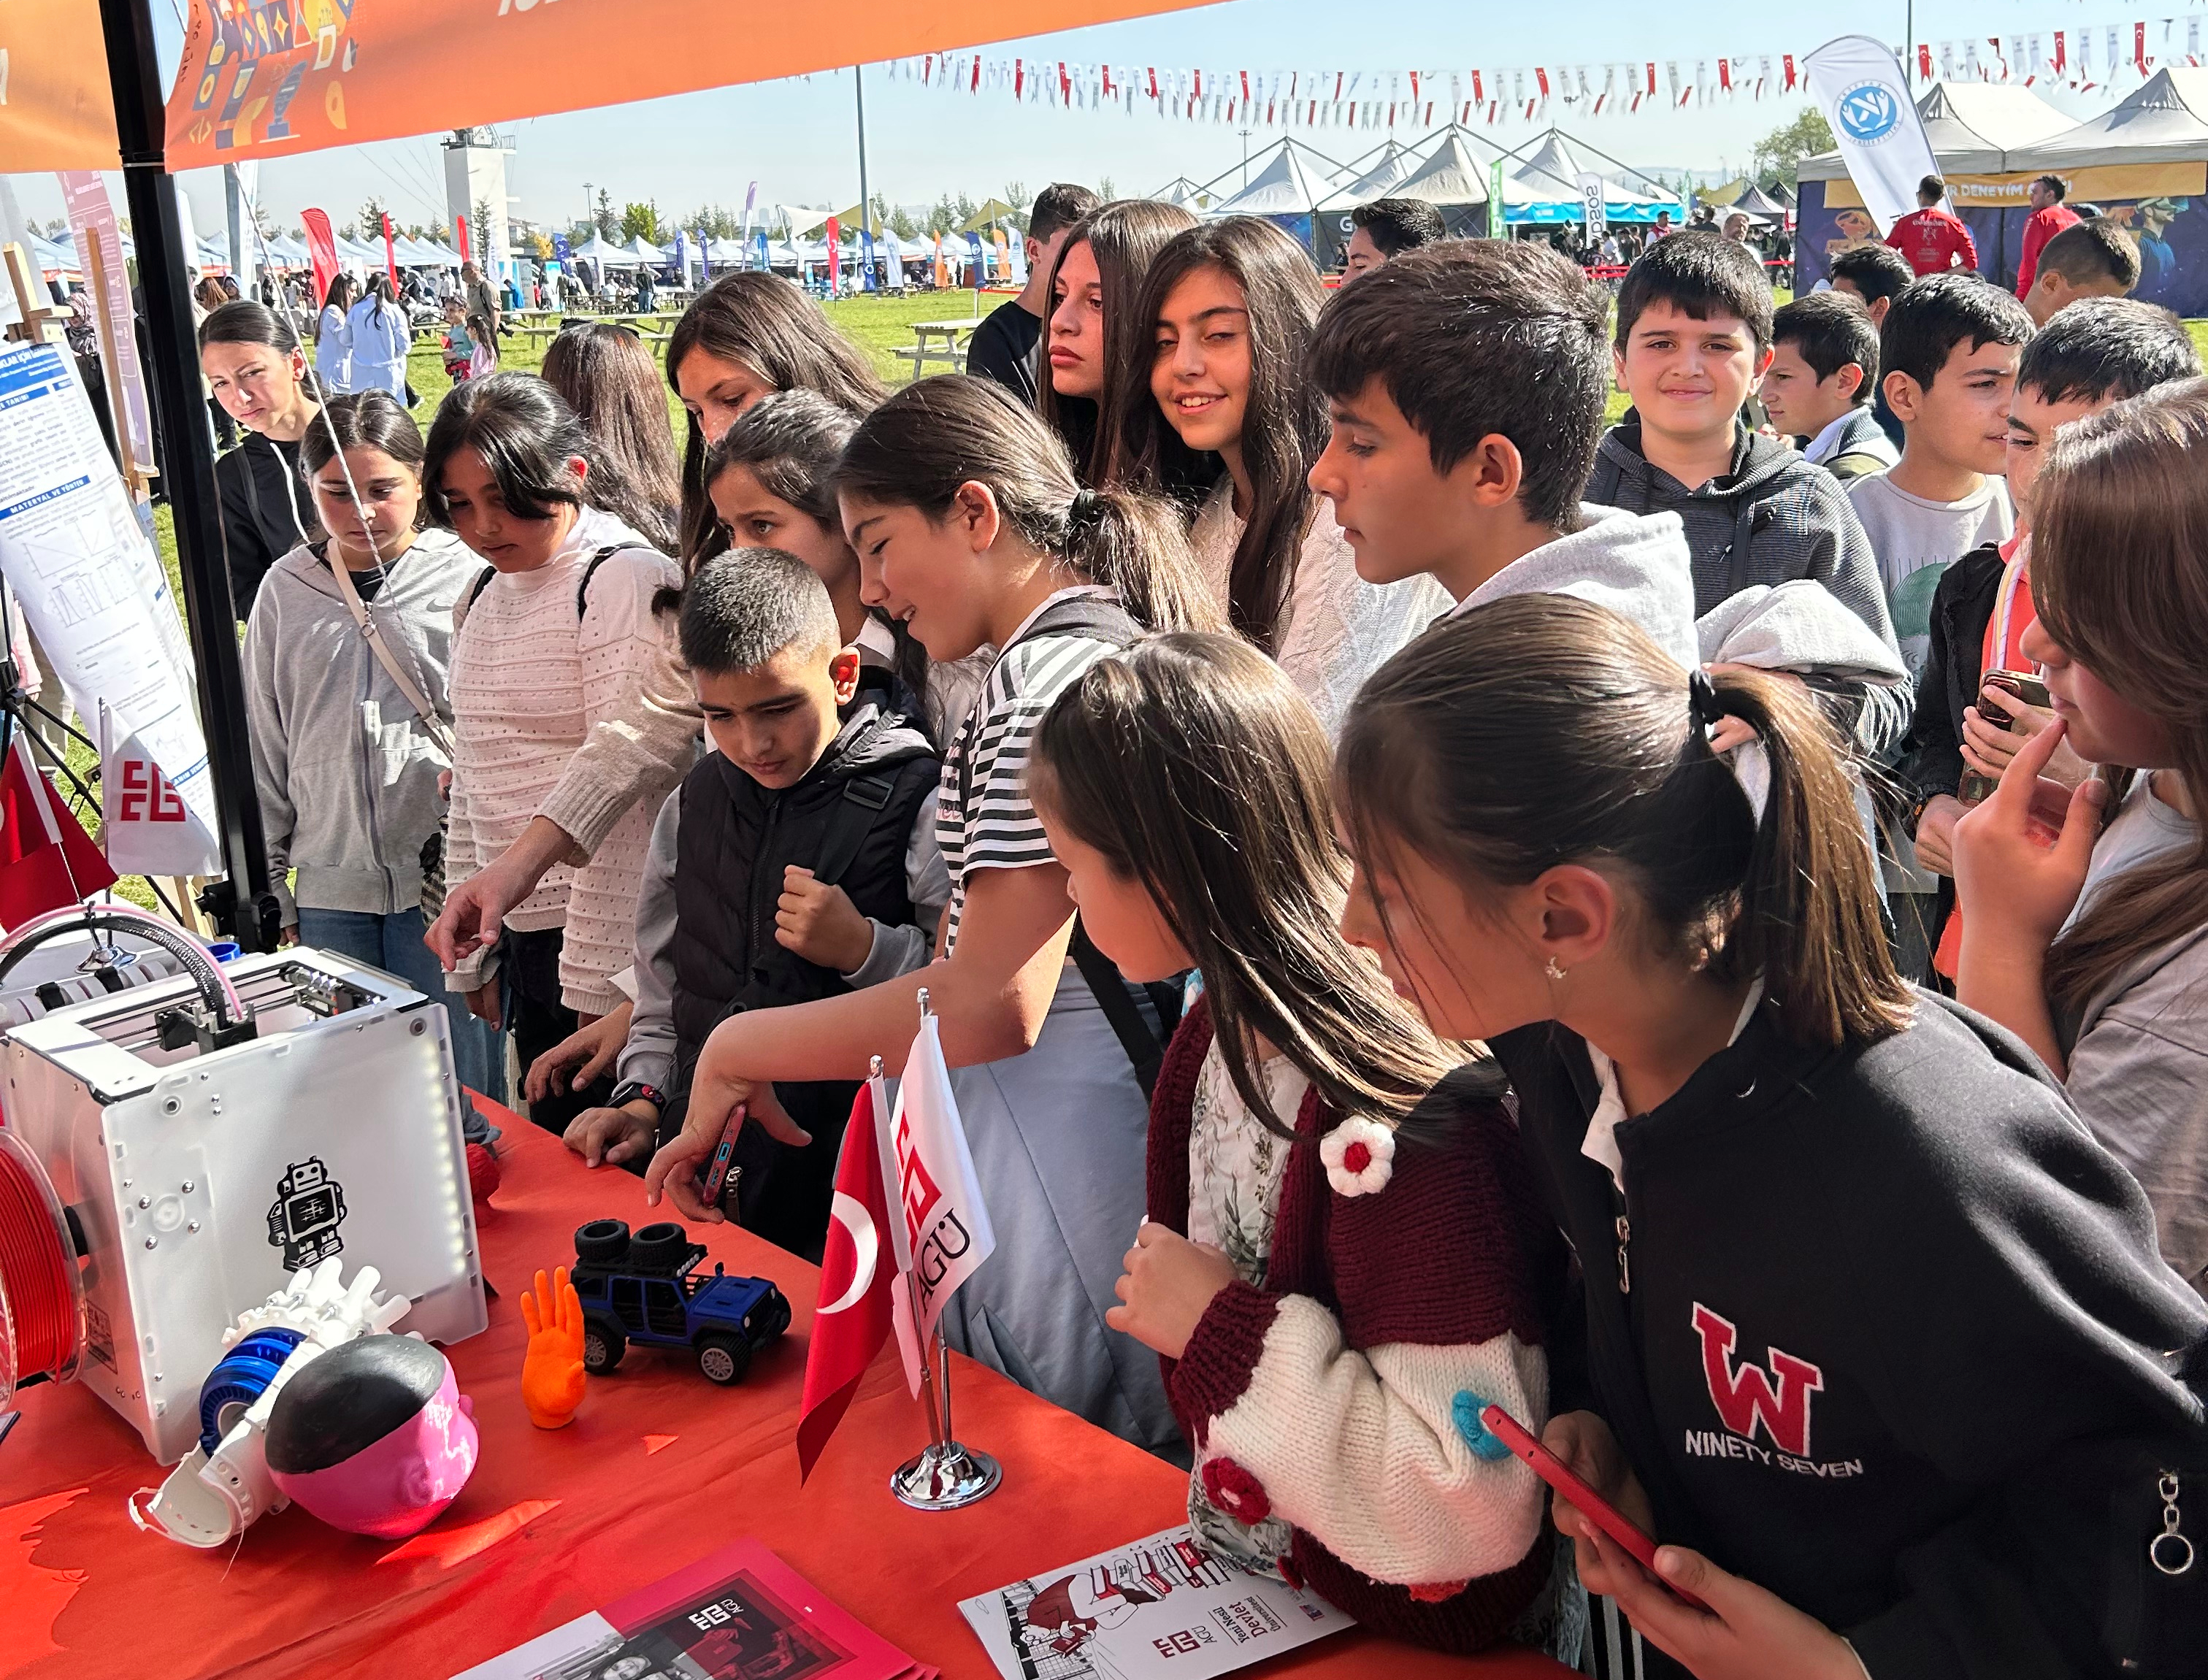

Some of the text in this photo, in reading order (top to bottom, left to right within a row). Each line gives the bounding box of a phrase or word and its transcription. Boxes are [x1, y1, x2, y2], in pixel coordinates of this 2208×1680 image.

[1961, 182, 2024, 197] DENEYİM
[917, 1207, 970, 1319] AGÜ
[1691, 1301, 1825, 1458] W
[1685, 1429, 1864, 1478] NINETY SEVEN
[720, 1598, 744, 1614] AGÜ
[1213, 1606, 1251, 1643] Yeni Nesil
[1228, 1601, 1268, 1638] Devlet
[1243, 1596, 1281, 1632] Üniversitesi
[1192, 1625, 1218, 1643] AGÜ
